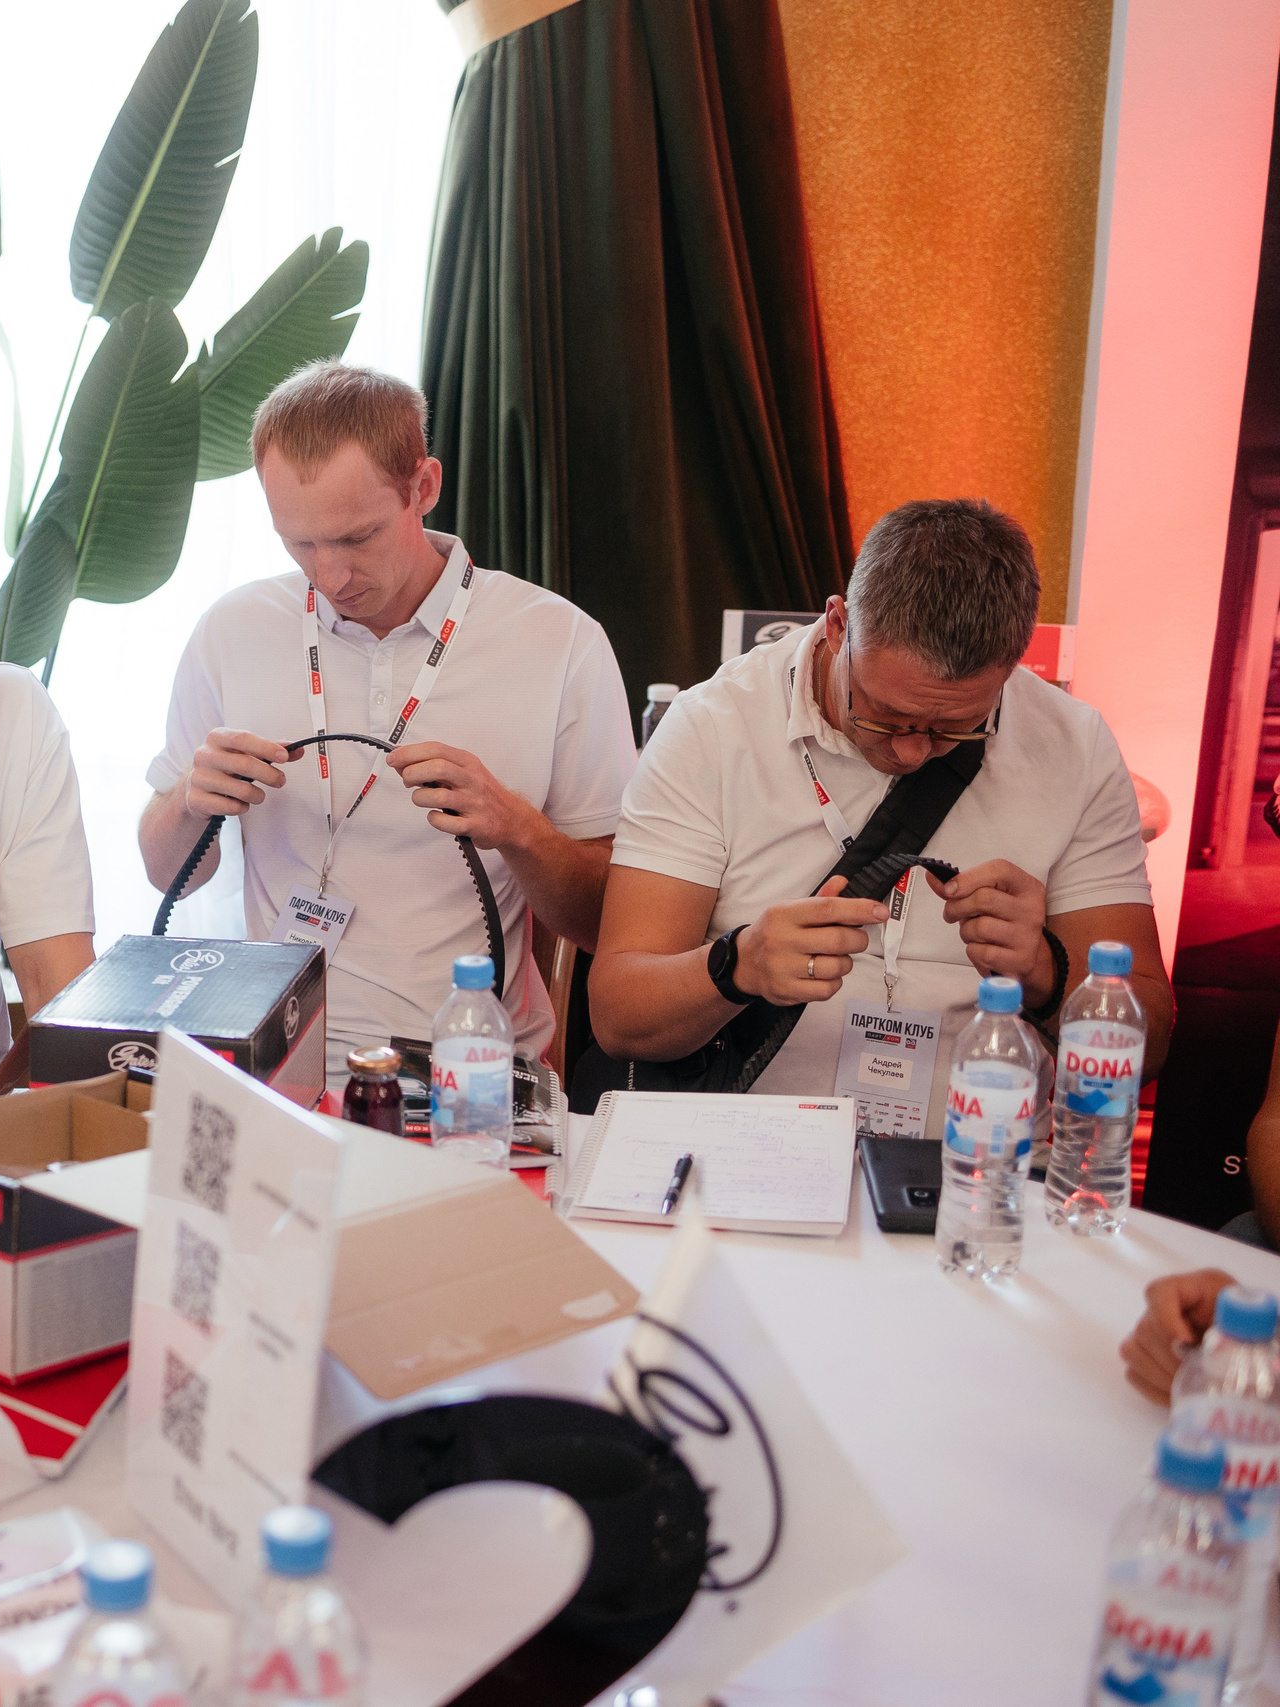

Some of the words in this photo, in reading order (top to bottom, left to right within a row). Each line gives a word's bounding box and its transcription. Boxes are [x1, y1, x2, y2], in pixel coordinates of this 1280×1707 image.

[462, 567, 473, 587] ПАРТ
[430, 644, 442, 664] ПАРТ
[442, 621, 453, 639] КОМ
[392, 721, 405, 741] ПАРТ
[405, 699, 416, 716] КОМ
[289, 896, 326, 918] ПАРТКОМ
[324, 908, 347, 925] КЛУБ
[893, 895, 902, 917] ПАРТ
[851, 1013, 903, 1034] ПАРТКОМ
[904, 1023, 934, 1039] КЛУБ
[868, 1065, 904, 1079] Чекулаев
[872, 1057, 902, 1069] Андрей
[1065, 1051, 1133, 1080] DONA
